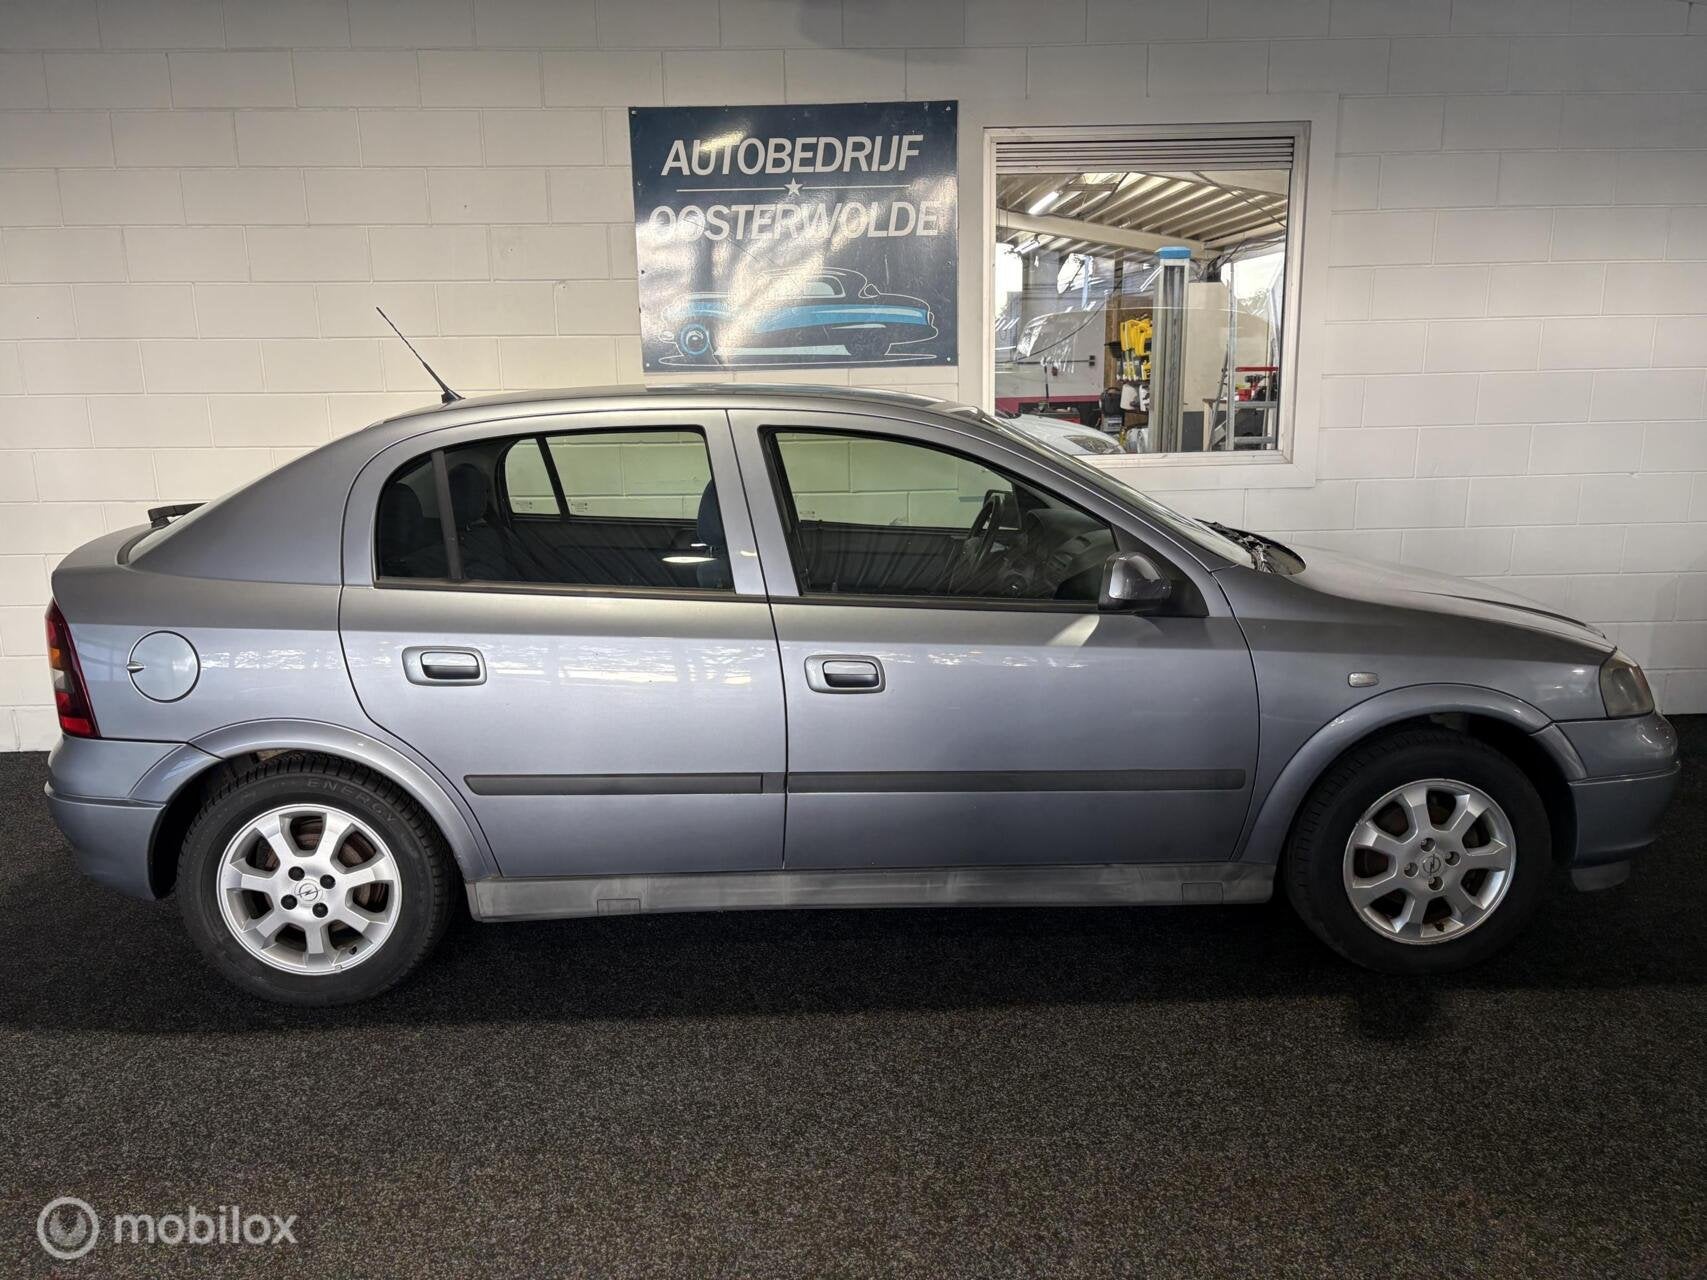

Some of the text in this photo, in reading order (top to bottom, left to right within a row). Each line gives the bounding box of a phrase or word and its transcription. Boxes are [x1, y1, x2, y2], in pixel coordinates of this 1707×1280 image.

[661, 134, 924, 176] AUTOBEDRIJF
[648, 200, 942, 242] OOSTERWOLDE
[306, 779, 397, 823] ENERGY
